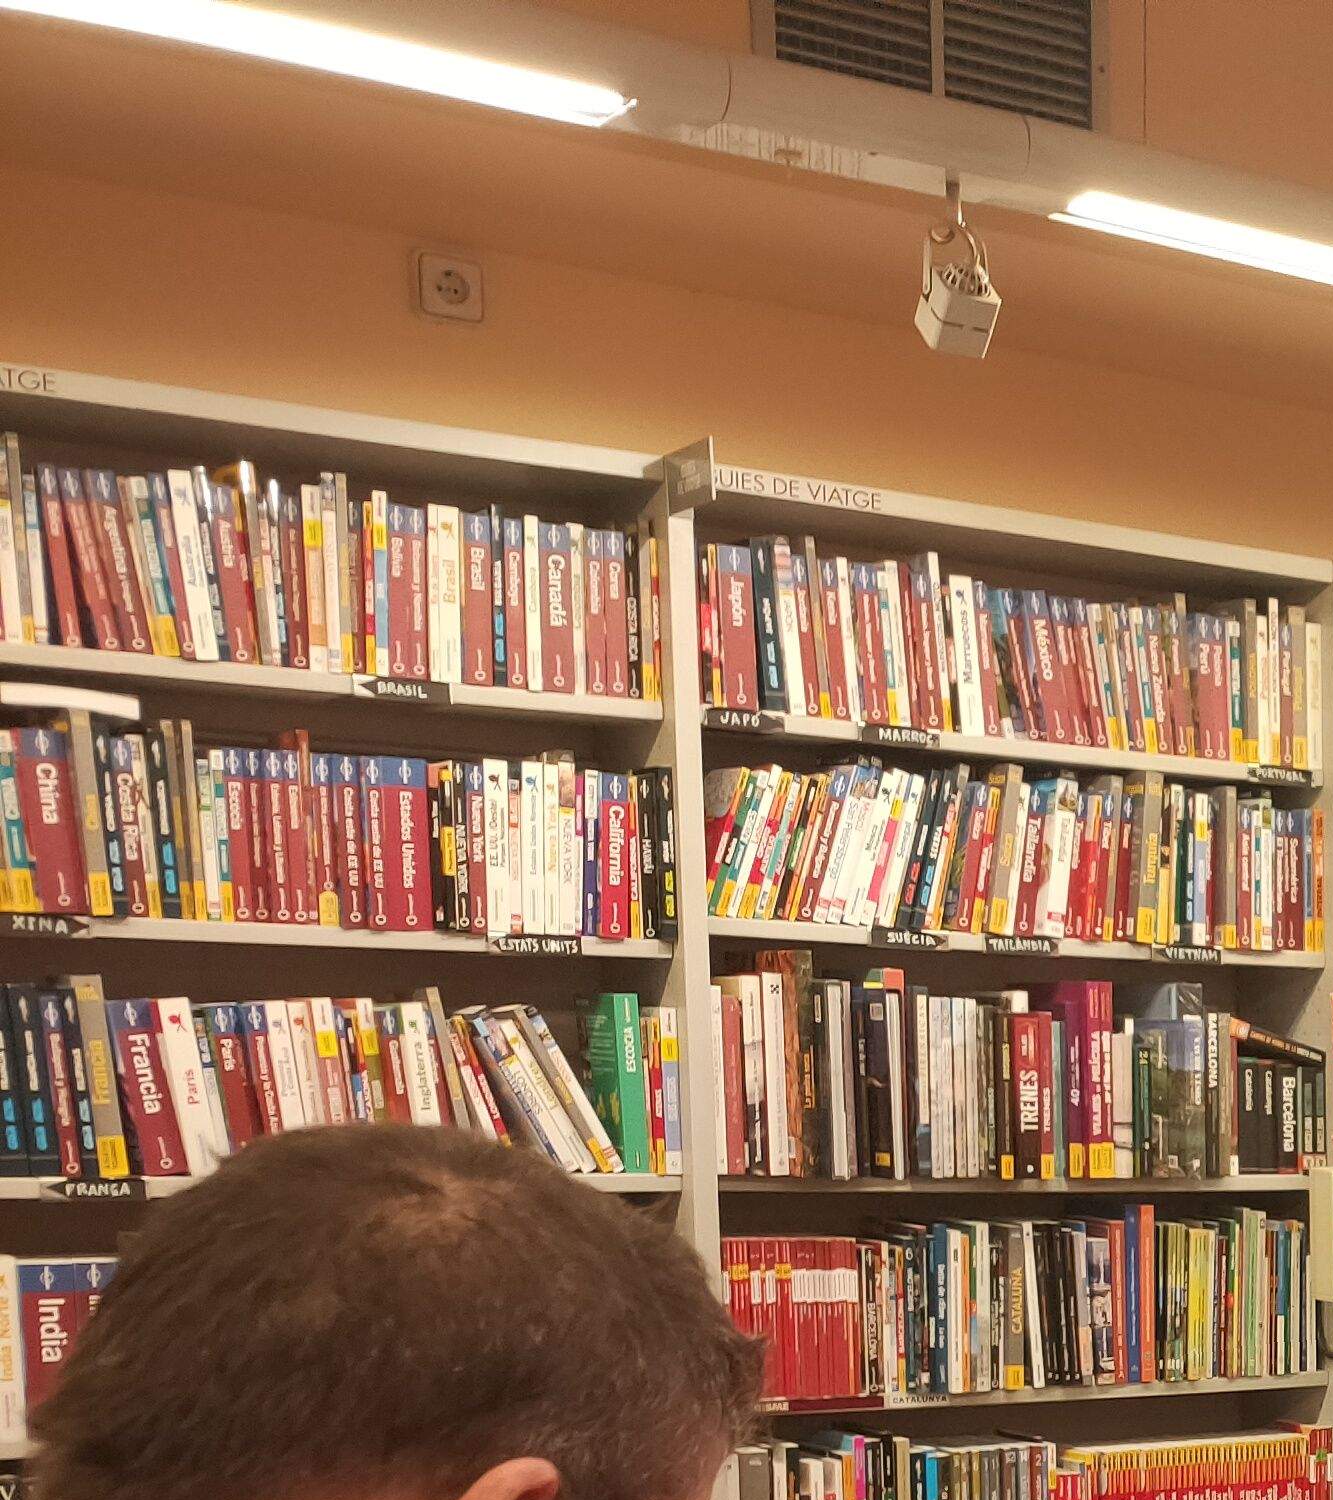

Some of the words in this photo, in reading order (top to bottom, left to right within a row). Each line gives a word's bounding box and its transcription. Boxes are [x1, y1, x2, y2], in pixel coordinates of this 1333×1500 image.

[773, 478, 800, 497] DE
[807, 482, 882, 511] VIATGE
[469, 545, 486, 591] Brasil
[546, 553, 569, 629] Canadá
[728, 577, 745, 627] Japón
[955, 609, 974, 684] Marruecos
[1033, 619, 1054, 681] México
[1199, 643, 1211, 675] Perú
[376, 680, 429, 700] BRASIL
[719, 711, 760, 728] JAPÓ
[878, 727, 938, 746] MARROC
[35, 762, 60, 825] China
[116, 772, 135, 823] Costa
[399, 791, 414, 841] Estados
[402, 842, 415, 889] Unidos
[607, 805, 627, 886] California
[1022, 816, 1041, 883] Tailandia
[12, 915, 69, 936] XINA
[499, 937, 539, 952] ESTATS
[541, 938, 578, 955] UNITS
[1165, 947, 1221, 963] VIETNAM
[127, 1033, 161, 1116] Francia
[1207, 1012, 1218, 1088] BARCELONA
[417, 1041, 434, 1111] Inglaterra
[1019, 1069, 1039, 1134] TRENES
[1282, 1076, 1297, 1152] Barcelona
[1010, 1267, 1024, 1334] CATALUÑA
[37, 1298, 68, 1363] India
[892, 1394, 949, 1404] CATALUNYA
